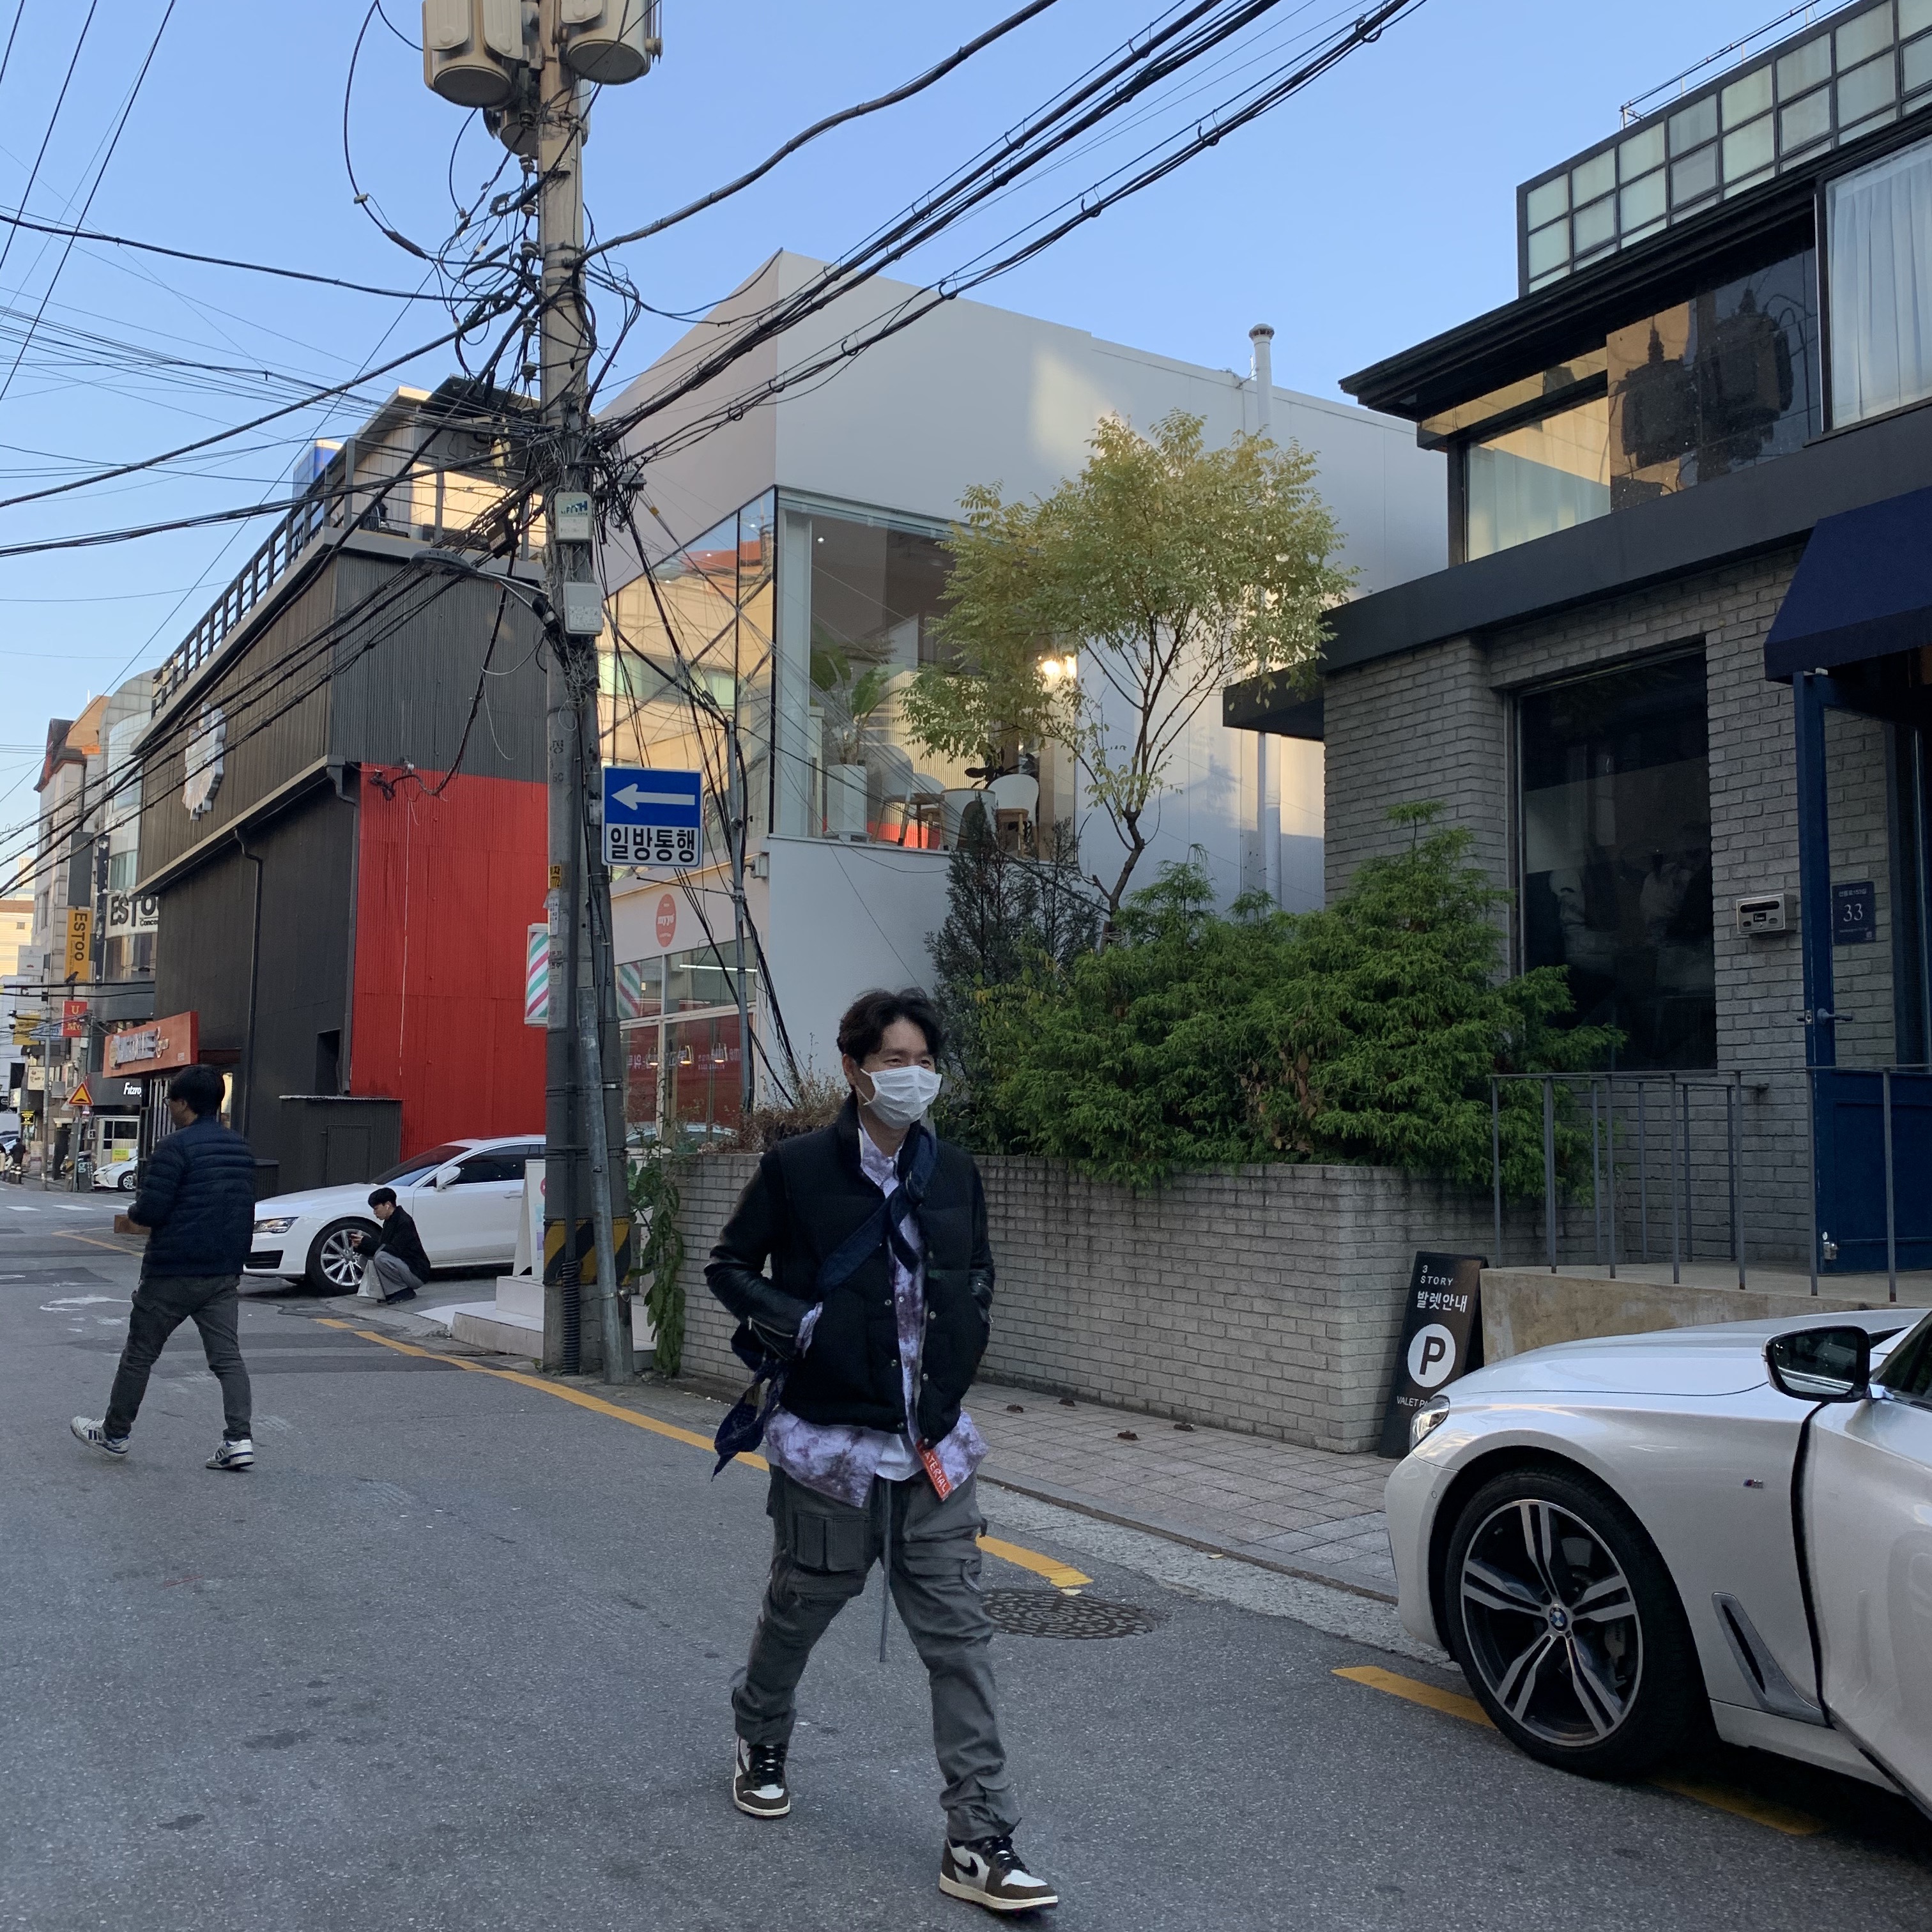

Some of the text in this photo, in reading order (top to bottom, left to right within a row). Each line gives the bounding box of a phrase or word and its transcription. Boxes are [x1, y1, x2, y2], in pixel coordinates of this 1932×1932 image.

[610, 827, 695, 862] 일방통행
[111, 895, 158, 927] ESTO
[1843, 903, 1863, 922] 33
[71, 913, 88, 961] ESTOO
[123, 1082, 142, 1098] Fitzro
[1422, 1264, 1428, 1273] 3
[1420, 1275, 1453, 1287] STORY
[1416, 1290, 1468, 1313] 발렛안내
[1419, 1336, 1446, 1376] P
[1397, 1395, 1419, 1406] VALET
